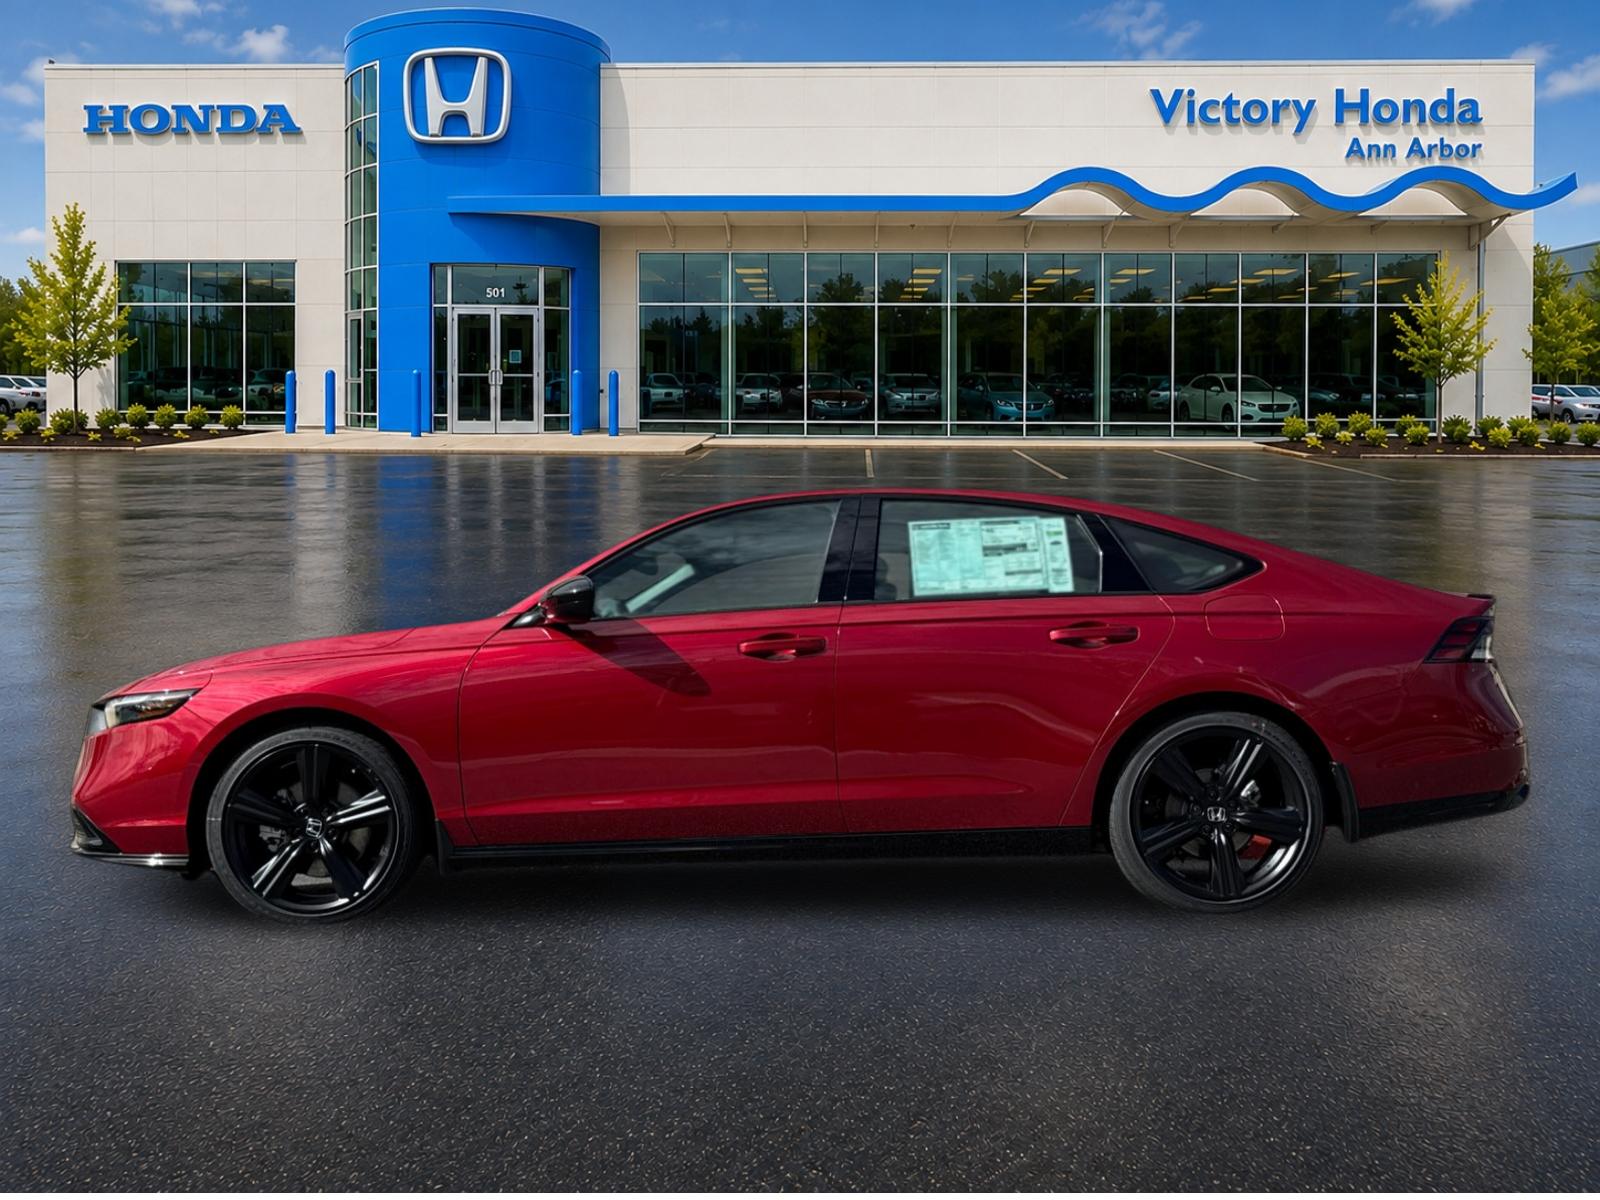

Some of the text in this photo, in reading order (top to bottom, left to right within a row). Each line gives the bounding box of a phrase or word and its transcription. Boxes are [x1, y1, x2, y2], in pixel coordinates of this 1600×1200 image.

[83, 103, 301, 135] HONDA
[1150, 87, 1483, 134] Victory Honda
[1345, 137, 1483, 160] Ann Arbor
[485, 287, 506, 298] 501
